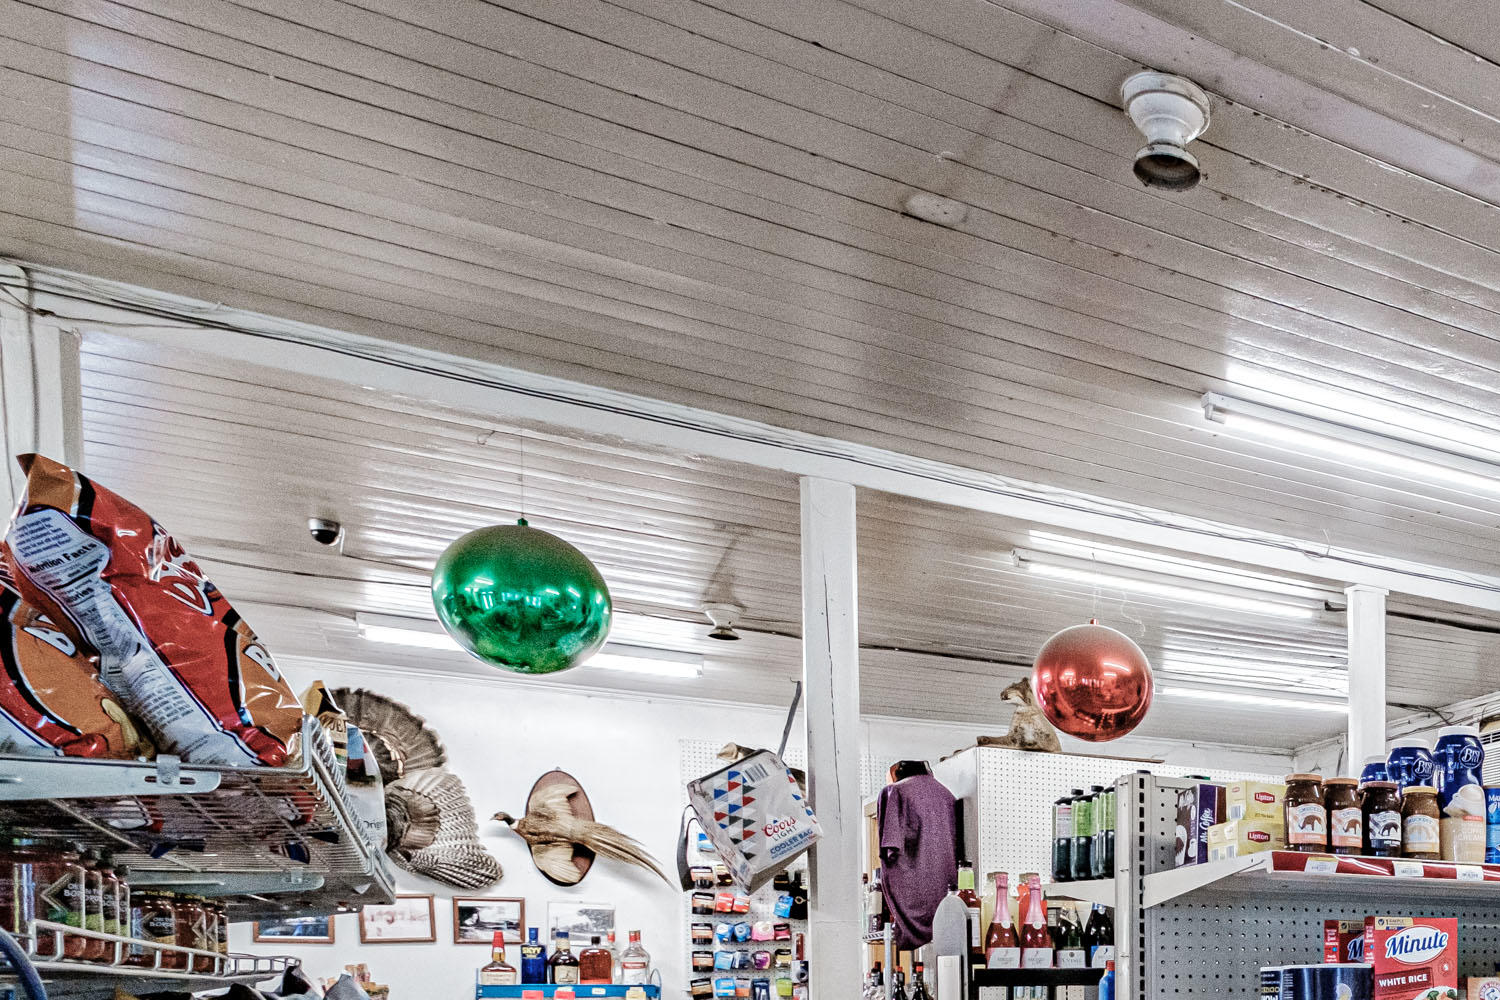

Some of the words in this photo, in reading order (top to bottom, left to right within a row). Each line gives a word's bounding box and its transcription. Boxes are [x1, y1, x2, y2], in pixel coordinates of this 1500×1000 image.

[1255, 793, 1274, 801] Lipton
[762, 816, 798, 837] Coors
[773, 826, 798, 841] LIGHT
[799, 828, 813, 840] BAG
[1248, 833, 1269, 841] Lipton
[1385, 932, 1448, 957] Minute
[1378, 977, 1407, 987] WHITE
[1408, 973, 1428, 983] RICE
